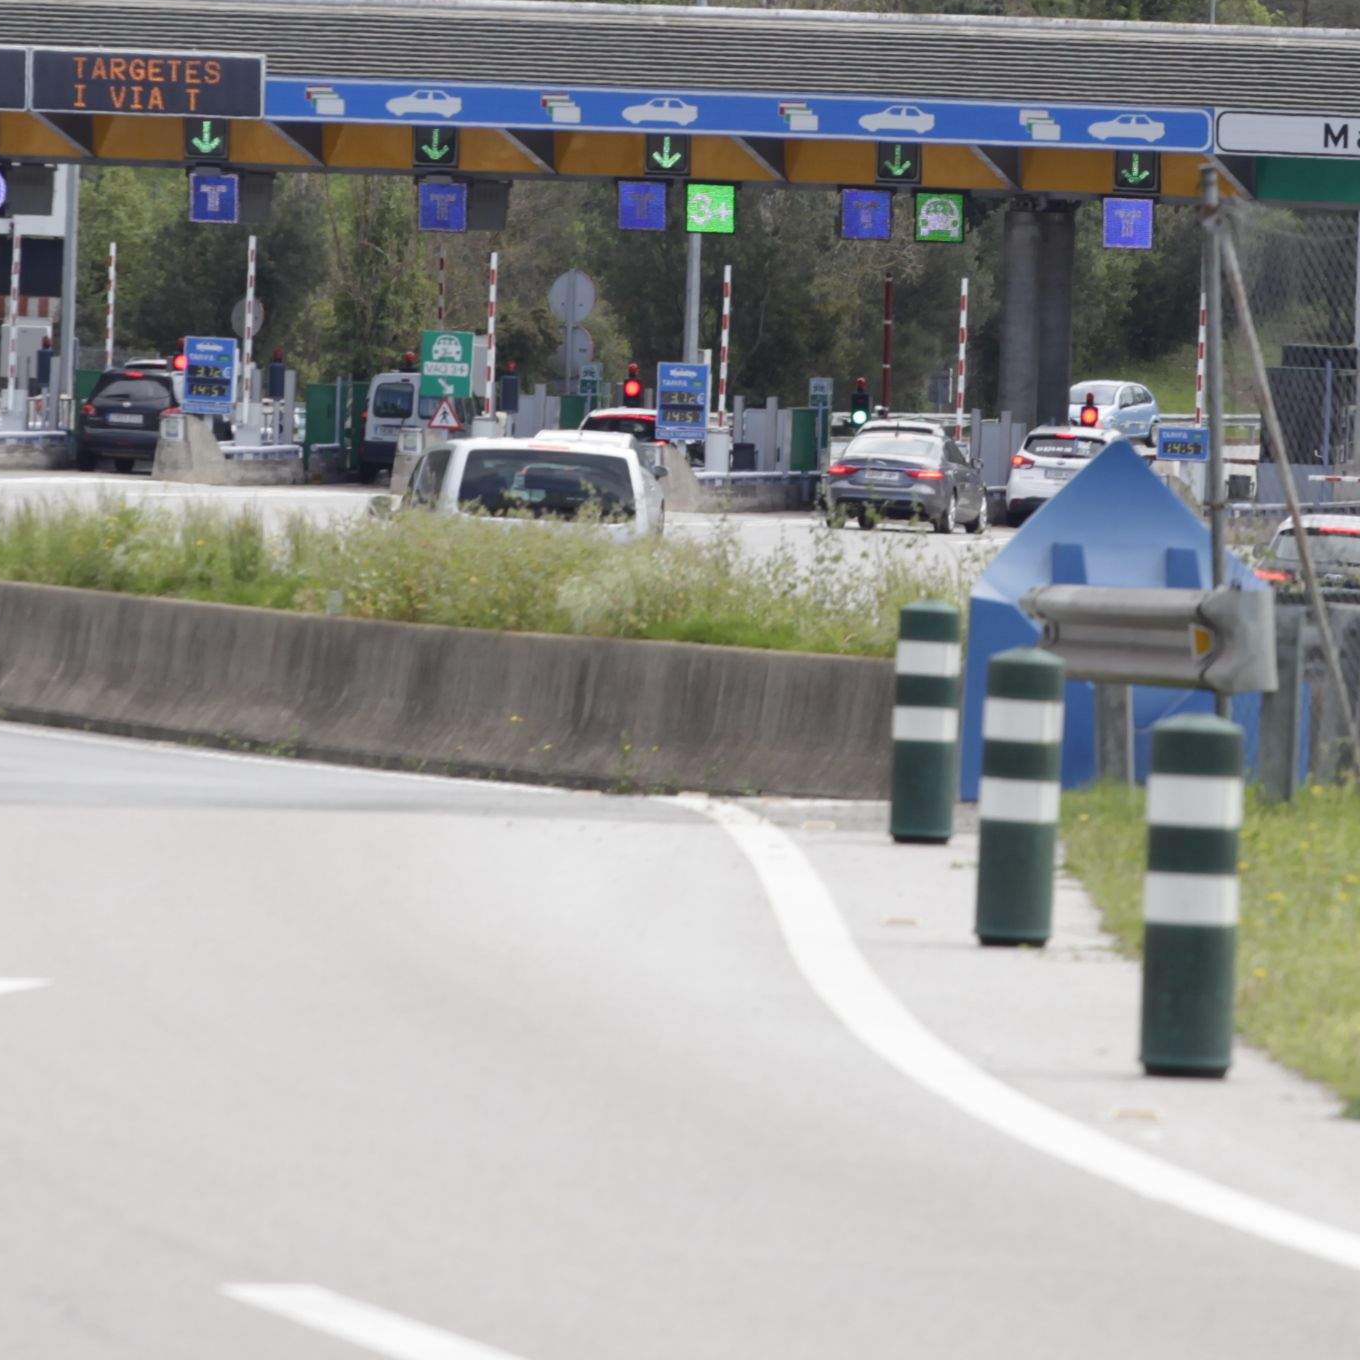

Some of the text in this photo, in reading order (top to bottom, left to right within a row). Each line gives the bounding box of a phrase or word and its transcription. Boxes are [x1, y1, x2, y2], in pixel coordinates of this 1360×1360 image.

[73, 56, 222, 85] TARGETES
[73, 84, 201, 113] I VIA T
[691, 193, 730, 225] 3+
